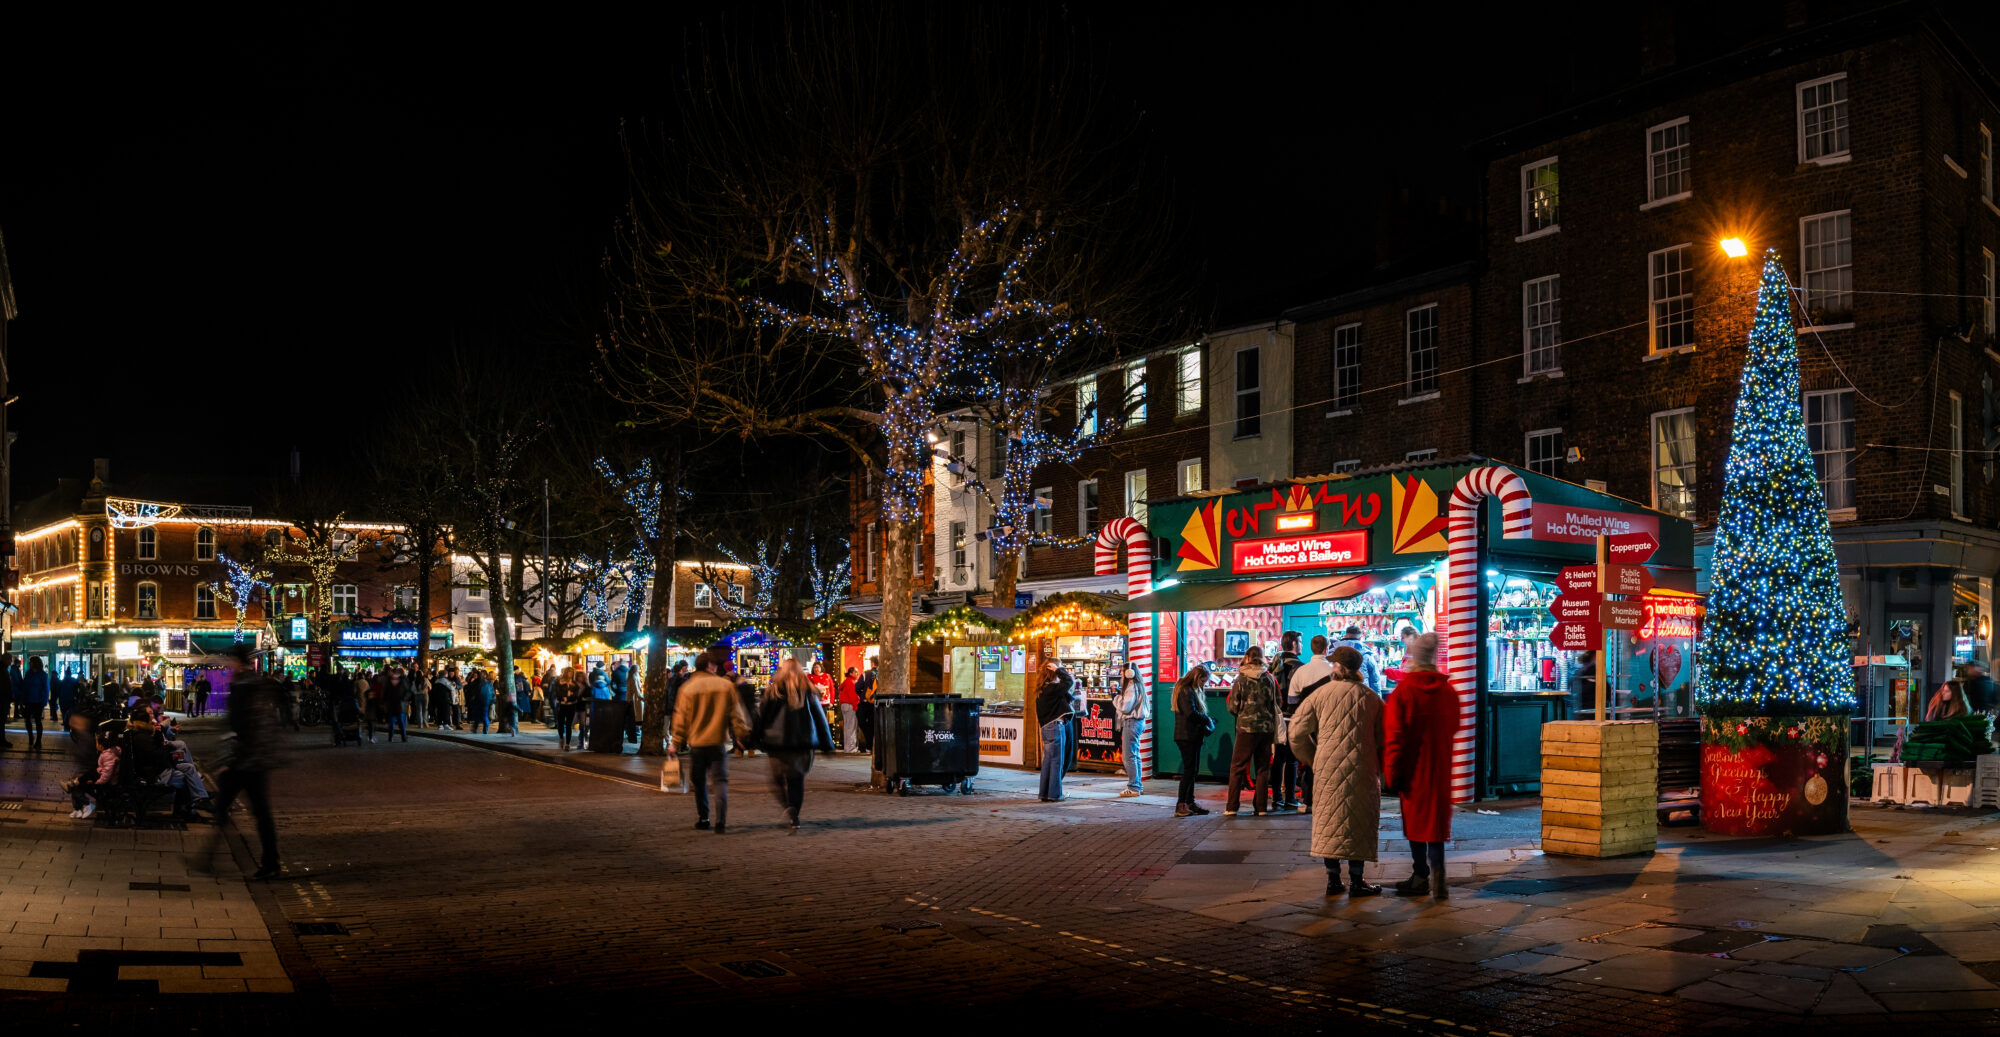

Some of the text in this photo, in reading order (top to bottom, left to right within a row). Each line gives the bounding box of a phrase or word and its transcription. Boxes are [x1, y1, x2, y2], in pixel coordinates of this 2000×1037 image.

[1566, 513, 1630, 529] Mulled Wine
[1547, 522, 1567, 535] Hot
[1569, 524, 1598, 537] Choc
[1263, 540, 1331, 554] Mulled Wine
[1610, 542, 1652, 553] Coppergate
[1244, 550, 1351, 567] Hot Choc & Baileys
[121, 564, 200, 576] BROWNS
[1565, 570, 1596, 579] St Helen's
[1621, 568, 1640, 578] Public
[960, 573, 966, 581] K
[1620, 575, 1641, 585] Toilets
[1569, 580, 1592, 589] Square
[1562, 608, 1590, 617] Gardens
[1611, 606, 1642, 616] Shambles
[1655, 602, 1668, 614] love
[1615, 617, 1638, 625] Market
[1565, 625, 1585, 633] Public
[343, 632, 418, 640] MULLED WINE & CIDER
[1564, 632, 1586, 640] Toilets
[992, 727, 997, 739] &
[997, 728, 1018, 740] BLOND
[1081, 727, 1113, 739] Jam Man
[1711, 763, 1769, 789] Greetings
[1743, 788, 1791, 812] Happy
[1714, 803, 1780, 828] New Year
